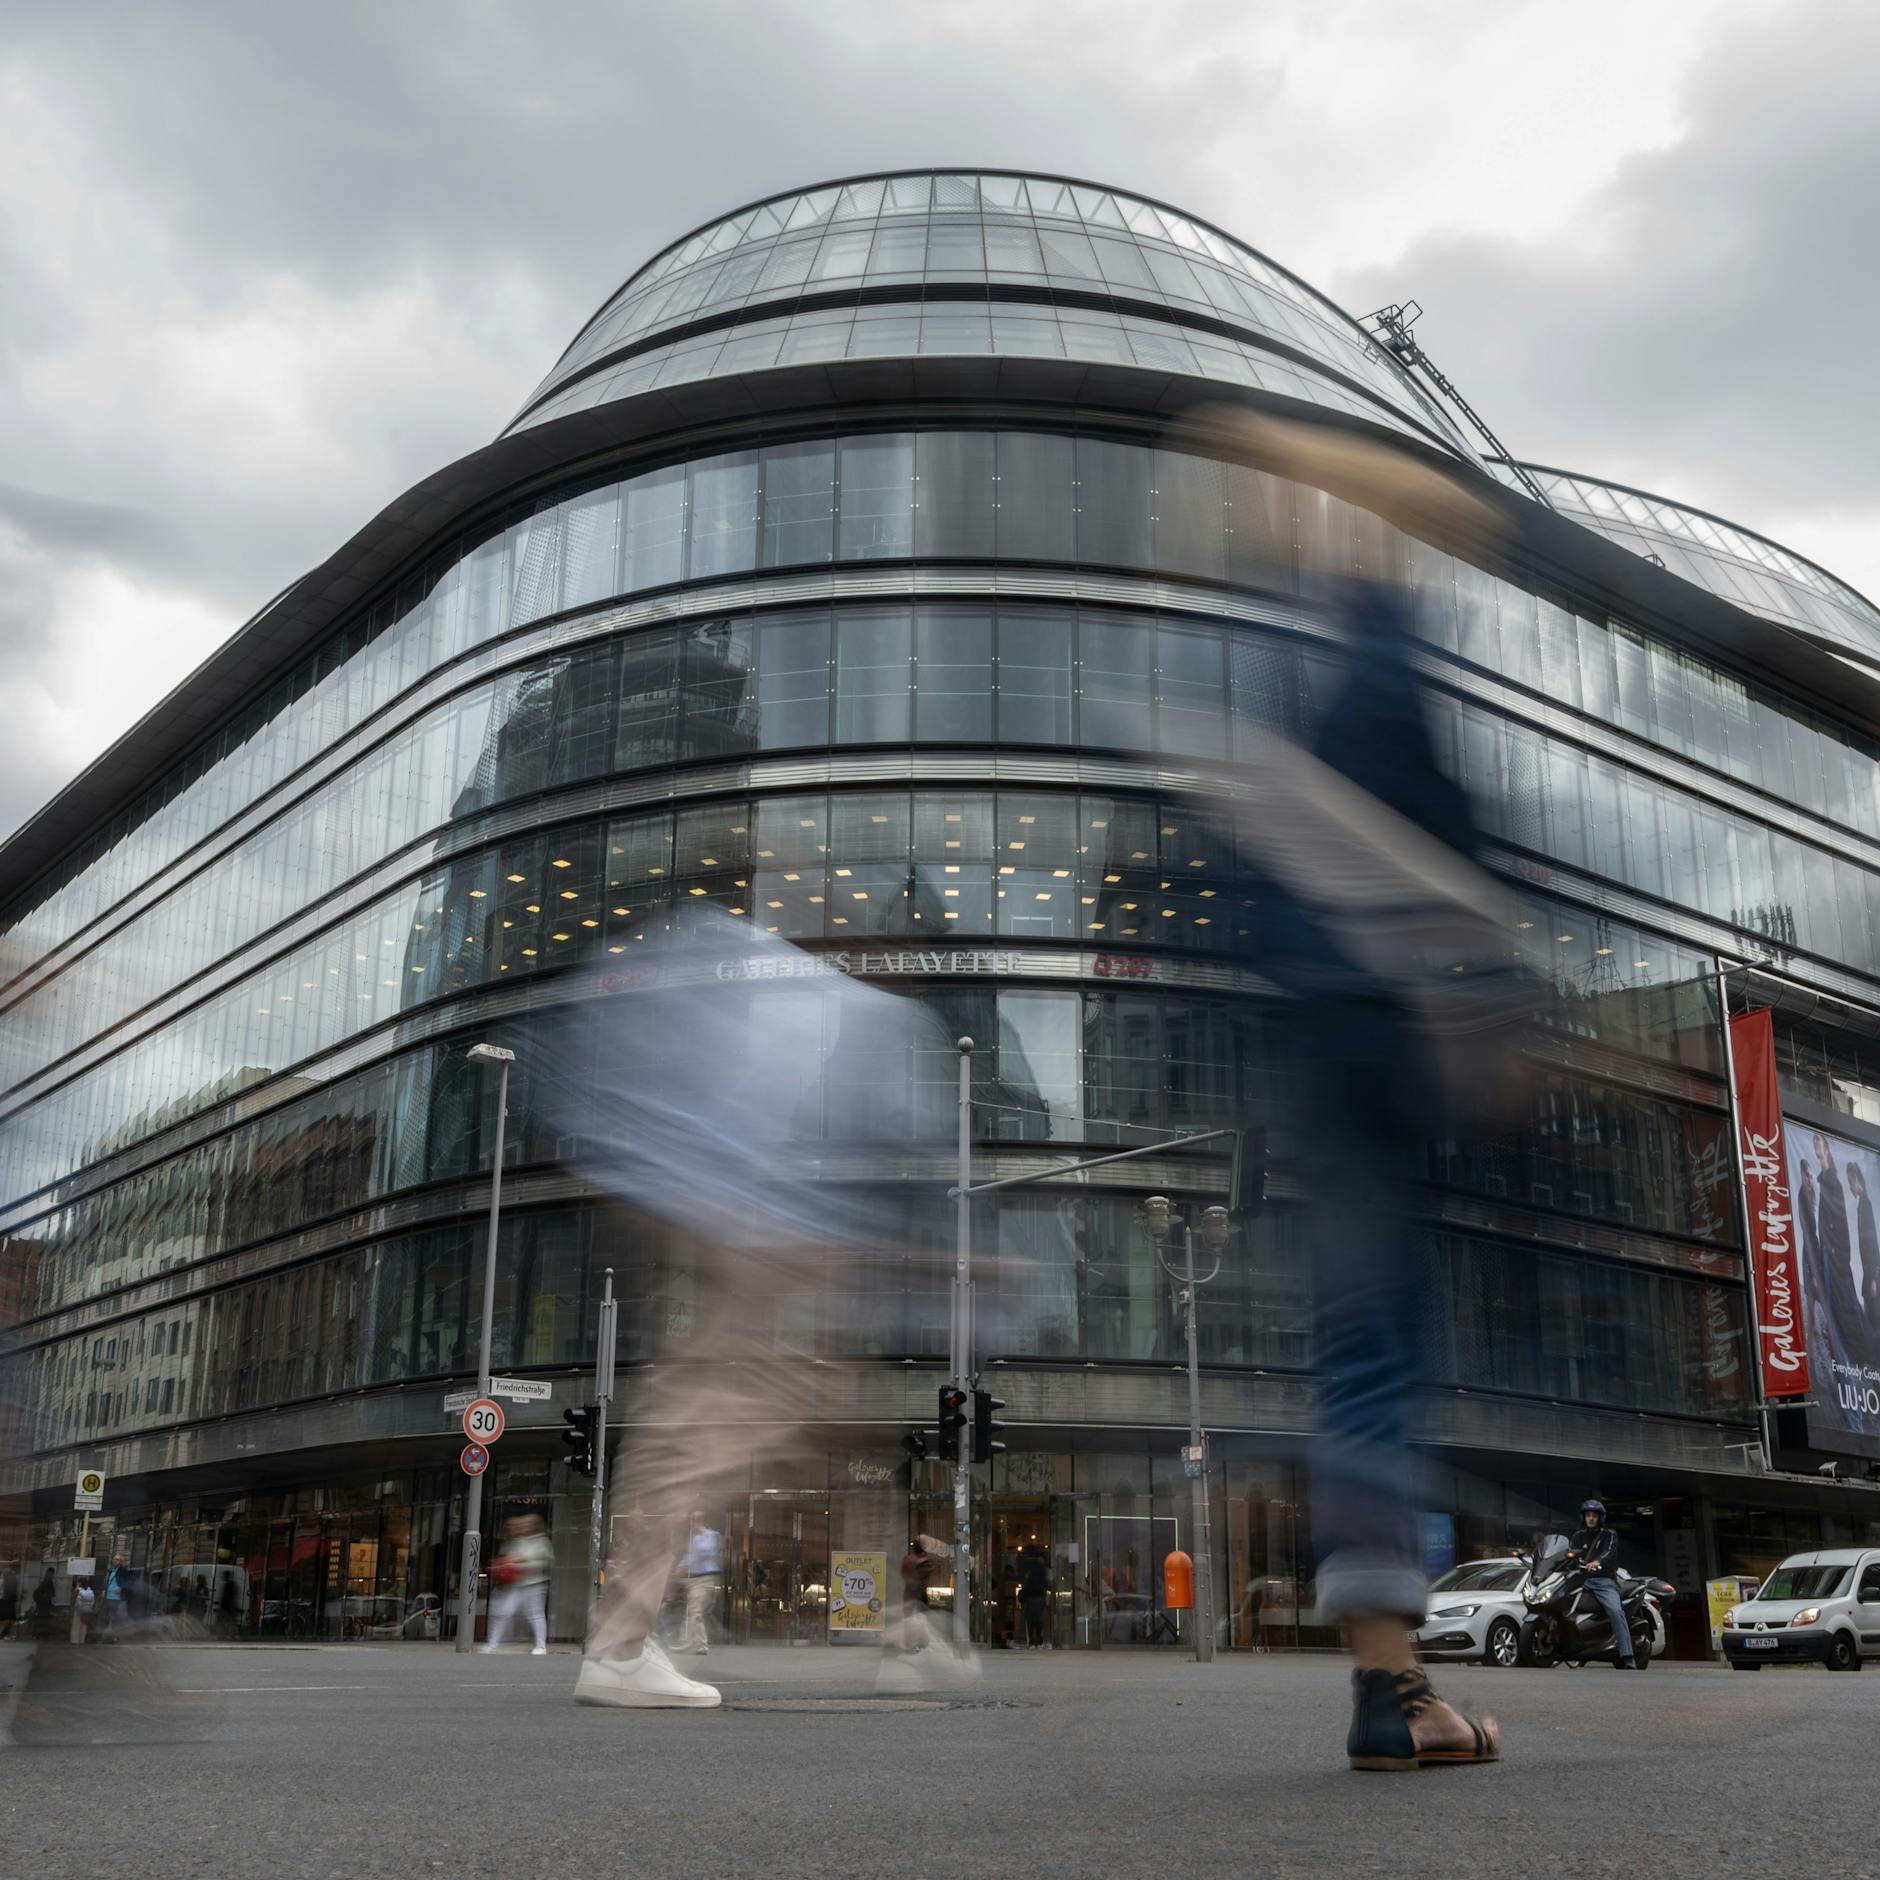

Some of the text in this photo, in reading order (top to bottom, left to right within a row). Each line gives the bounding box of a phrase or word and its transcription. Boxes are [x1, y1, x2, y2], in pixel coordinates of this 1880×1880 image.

[861, 951, 1022, 974] LAFAYETTE
[1743, 1123, 1807, 1371] Galeries Lafayette
[1831, 1359, 1862, 1381] Everybody
[496, 1382, 546, 1396] Friedrichstraße
[472, 1410, 496, 1432] 30
[87, 1478, 97, 1489] H
[845, 1557, 873, 1565] OUTLET
